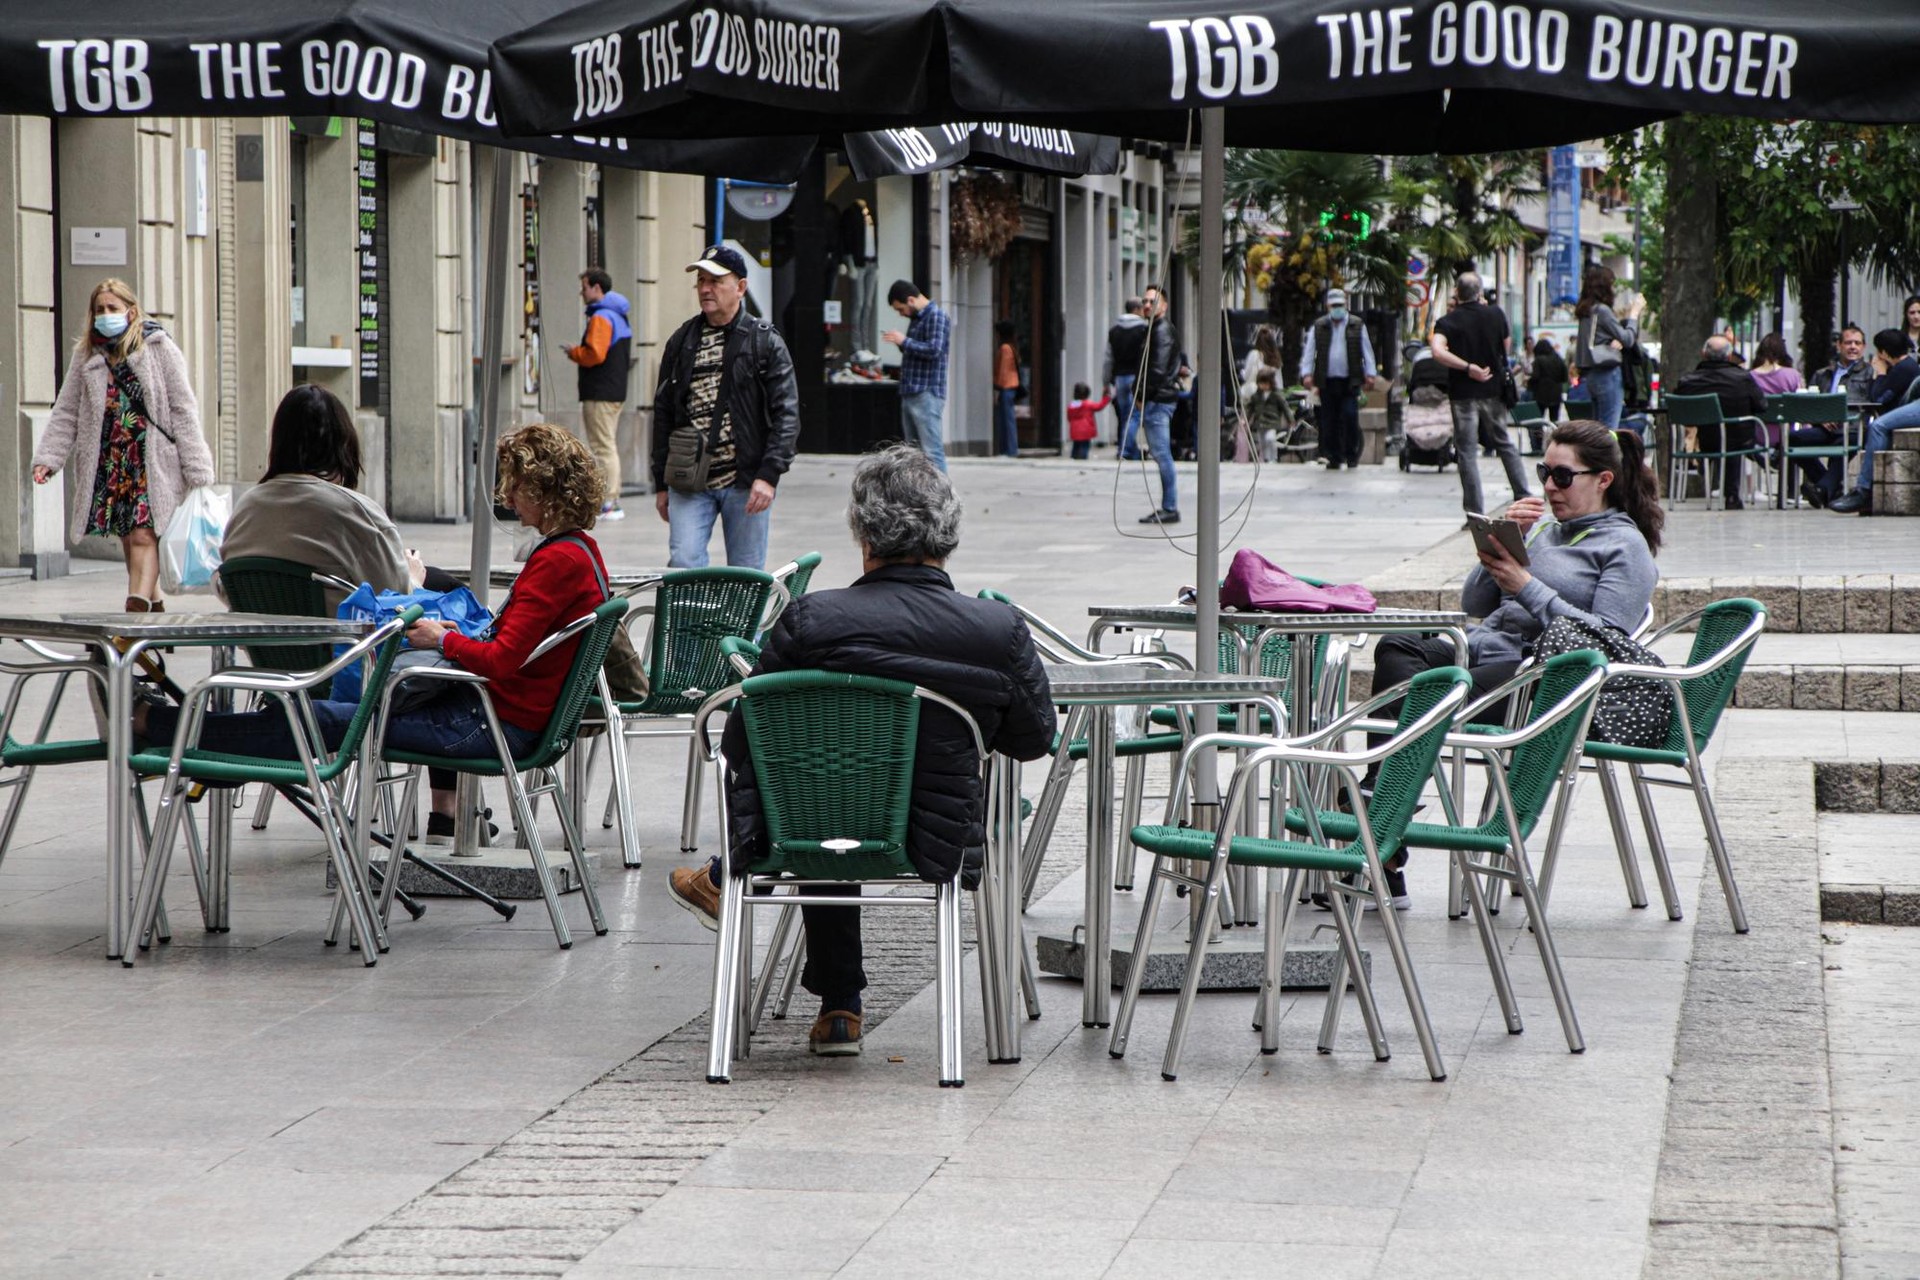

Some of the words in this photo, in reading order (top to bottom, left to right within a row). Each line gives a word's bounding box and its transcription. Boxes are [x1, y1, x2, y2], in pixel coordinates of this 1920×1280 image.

[36, 38, 153, 113] TGB
[189, 41, 286, 100] THE
[301, 39, 427, 109] GOOD
[571, 32, 624, 122] TGB
[637, 20, 684, 92] THE
[754, 17, 840, 92] BURGER
[1148, 14, 1280, 101] TGB
[1315, 7, 1414, 79] THE
[1430, 0, 1569, 75] GOOD
[1587, 14, 1799, 100] BURGER
